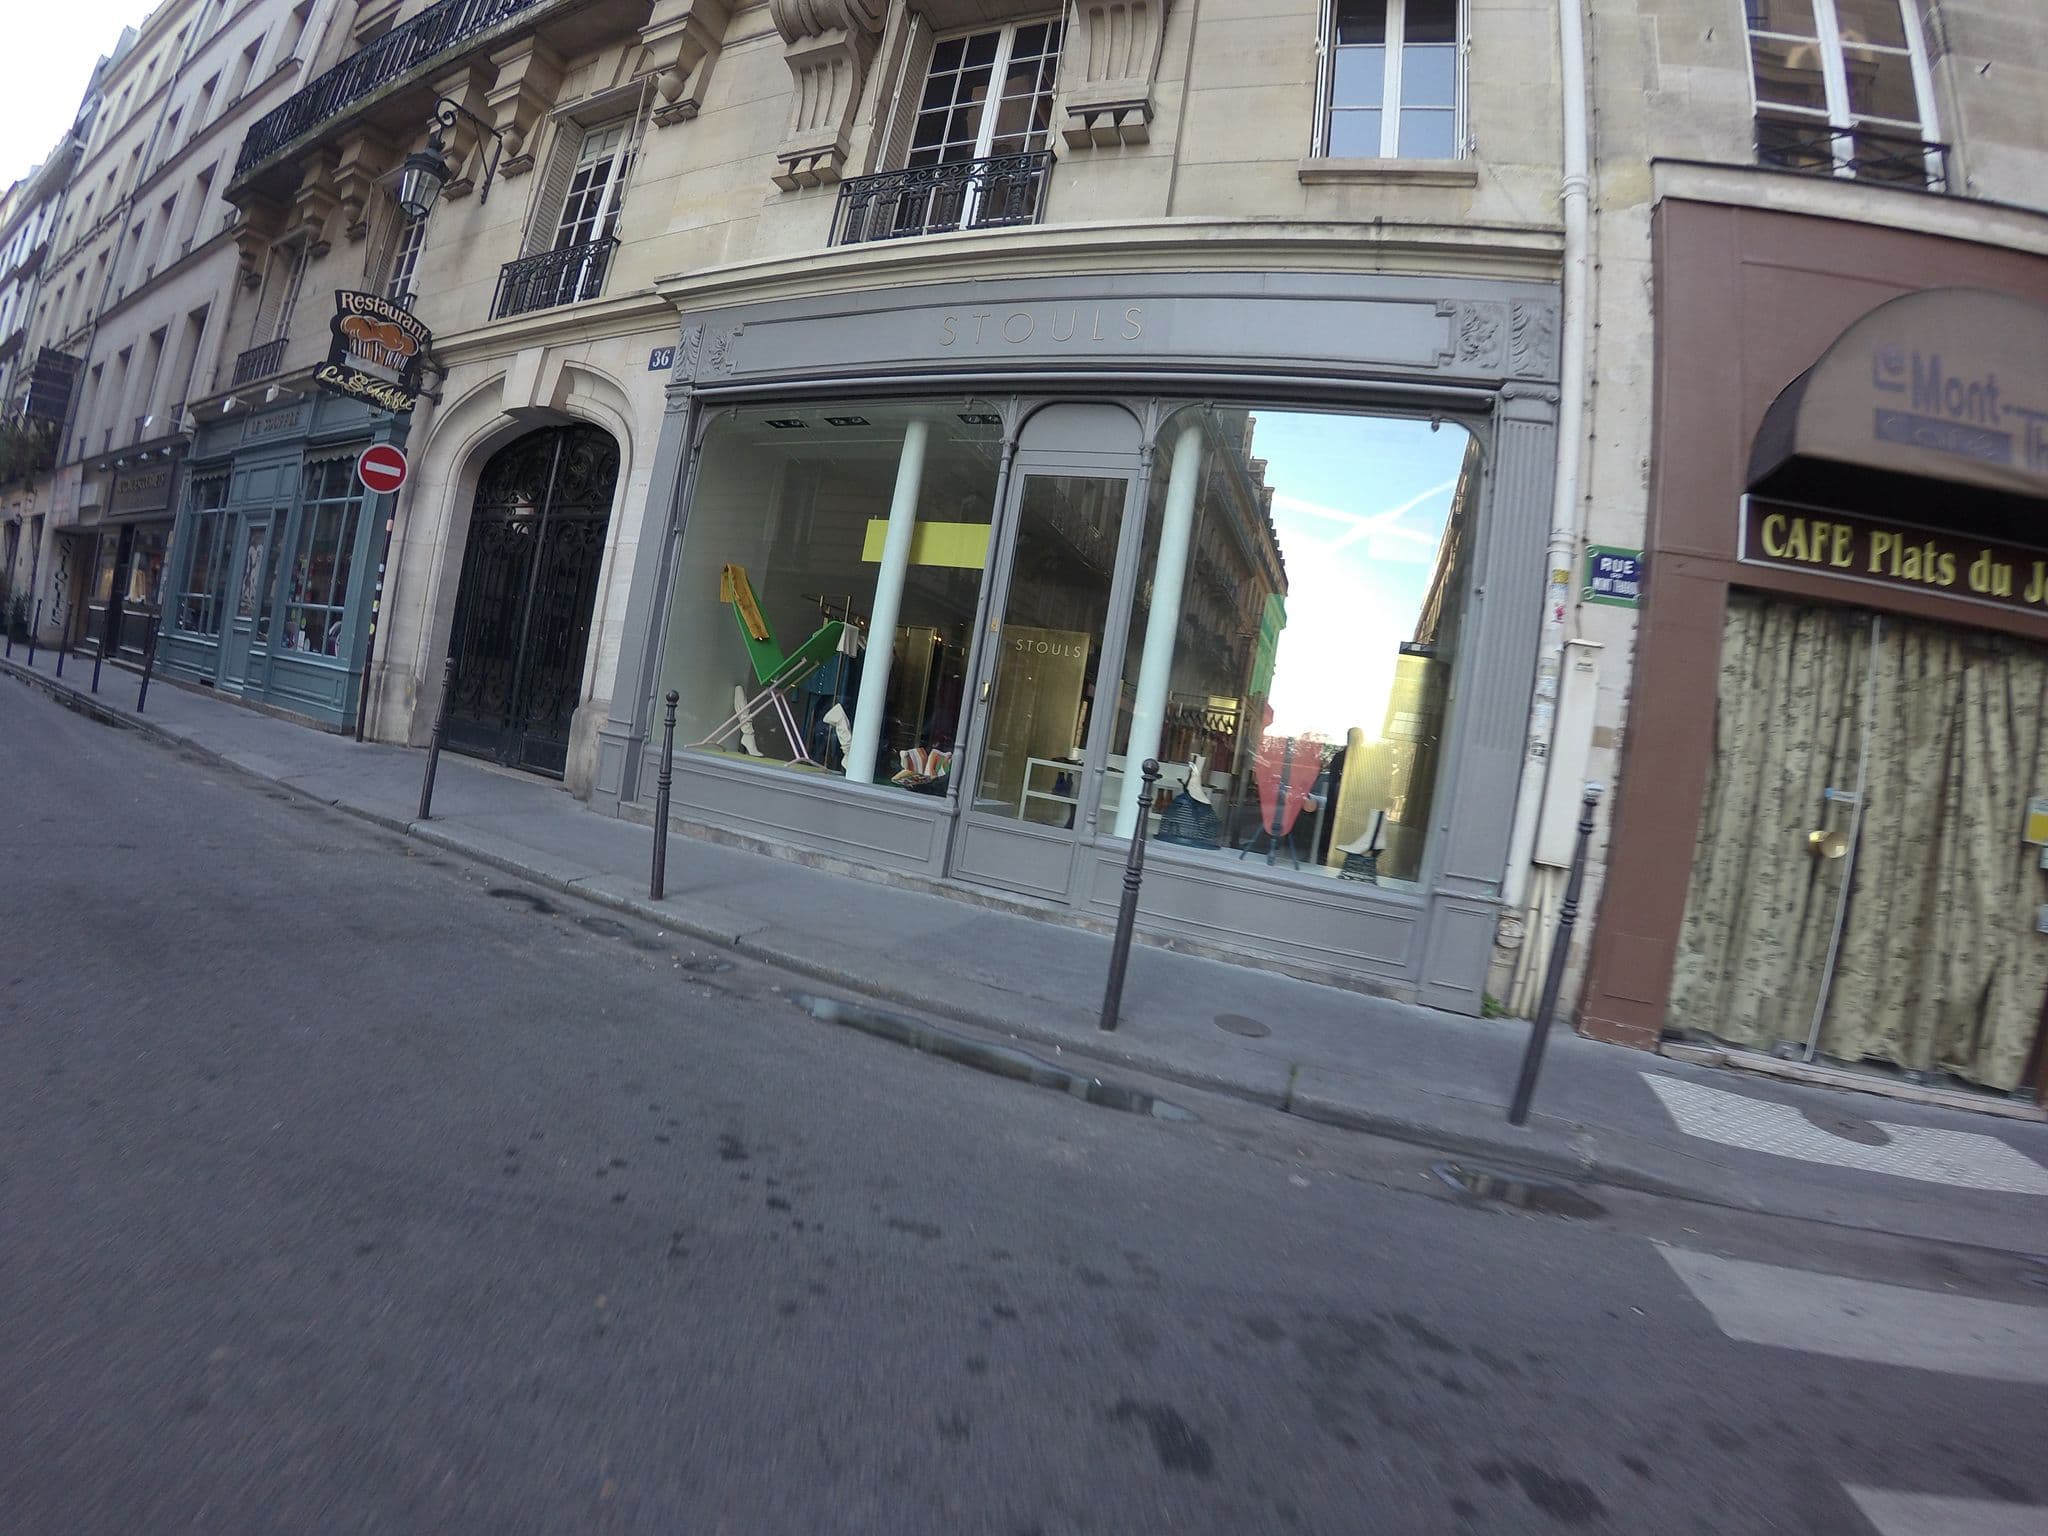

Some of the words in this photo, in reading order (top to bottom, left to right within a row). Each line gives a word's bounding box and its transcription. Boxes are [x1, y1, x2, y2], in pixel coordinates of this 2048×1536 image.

[341, 291, 428, 341] Restaurant
[939, 307, 1143, 346] STOULS
[652, 350, 671, 368] 36
[315, 365, 345, 386] Le
[1600, 557, 1635, 574] RUE
[1761, 513, 1854, 568] CAFE
[1866, 530, 1956, 586] Plats
[1968, 549, 2013, 598] du
[1015, 638, 1081, 658] STOULS
